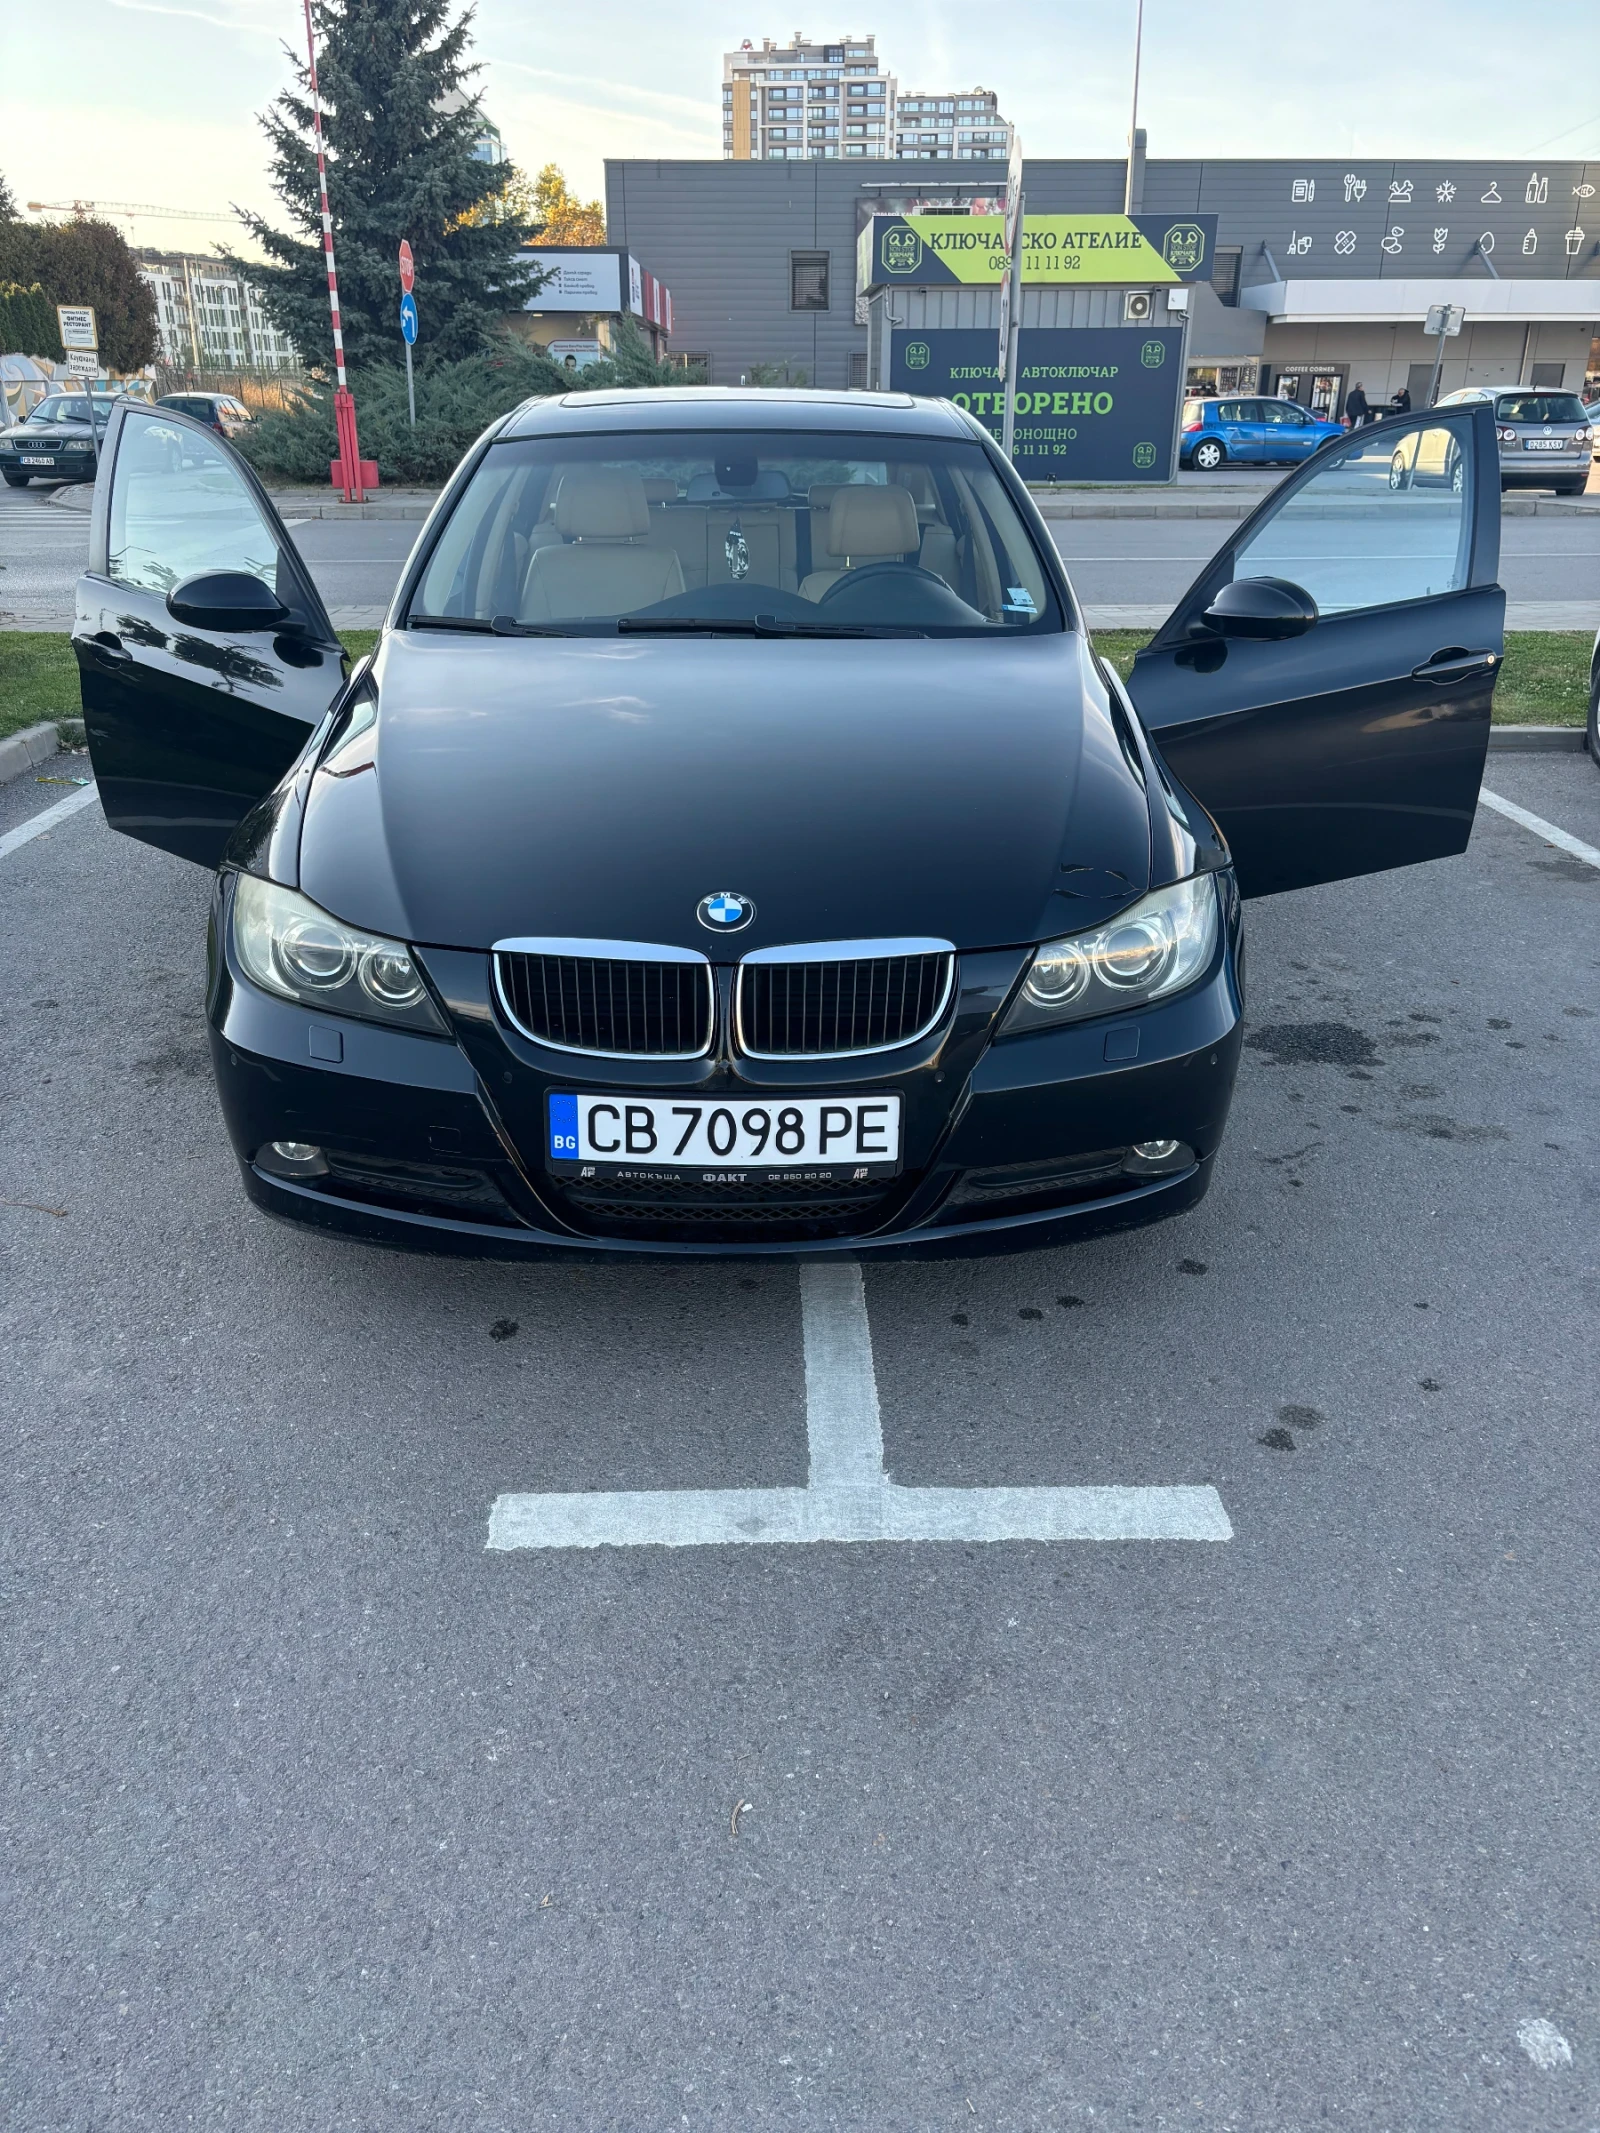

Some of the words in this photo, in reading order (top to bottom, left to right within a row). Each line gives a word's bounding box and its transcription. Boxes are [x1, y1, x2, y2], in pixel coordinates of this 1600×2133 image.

[930, 232, 1057, 249] КЛЮЧАСКО
[1062, 231, 1143, 249] АТЕЛИЕ
[401, 256, 413, 277] STOP
[1026, 255, 1040, 270] 11
[1045, 255, 1059, 269] 11
[1064, 255, 1081, 270] 92
[1021, 366, 1119, 378] АВТОКЛЮЧАР
[1053, 444, 1067, 455] 92
[703, 892, 749, 905] BMW
[671, 1106, 805, 1157] 7098
[554, 1135, 576, 1150] BG
[702, 1173, 748, 1183] ФАКТ
[804, 1172, 817, 1180] 20
